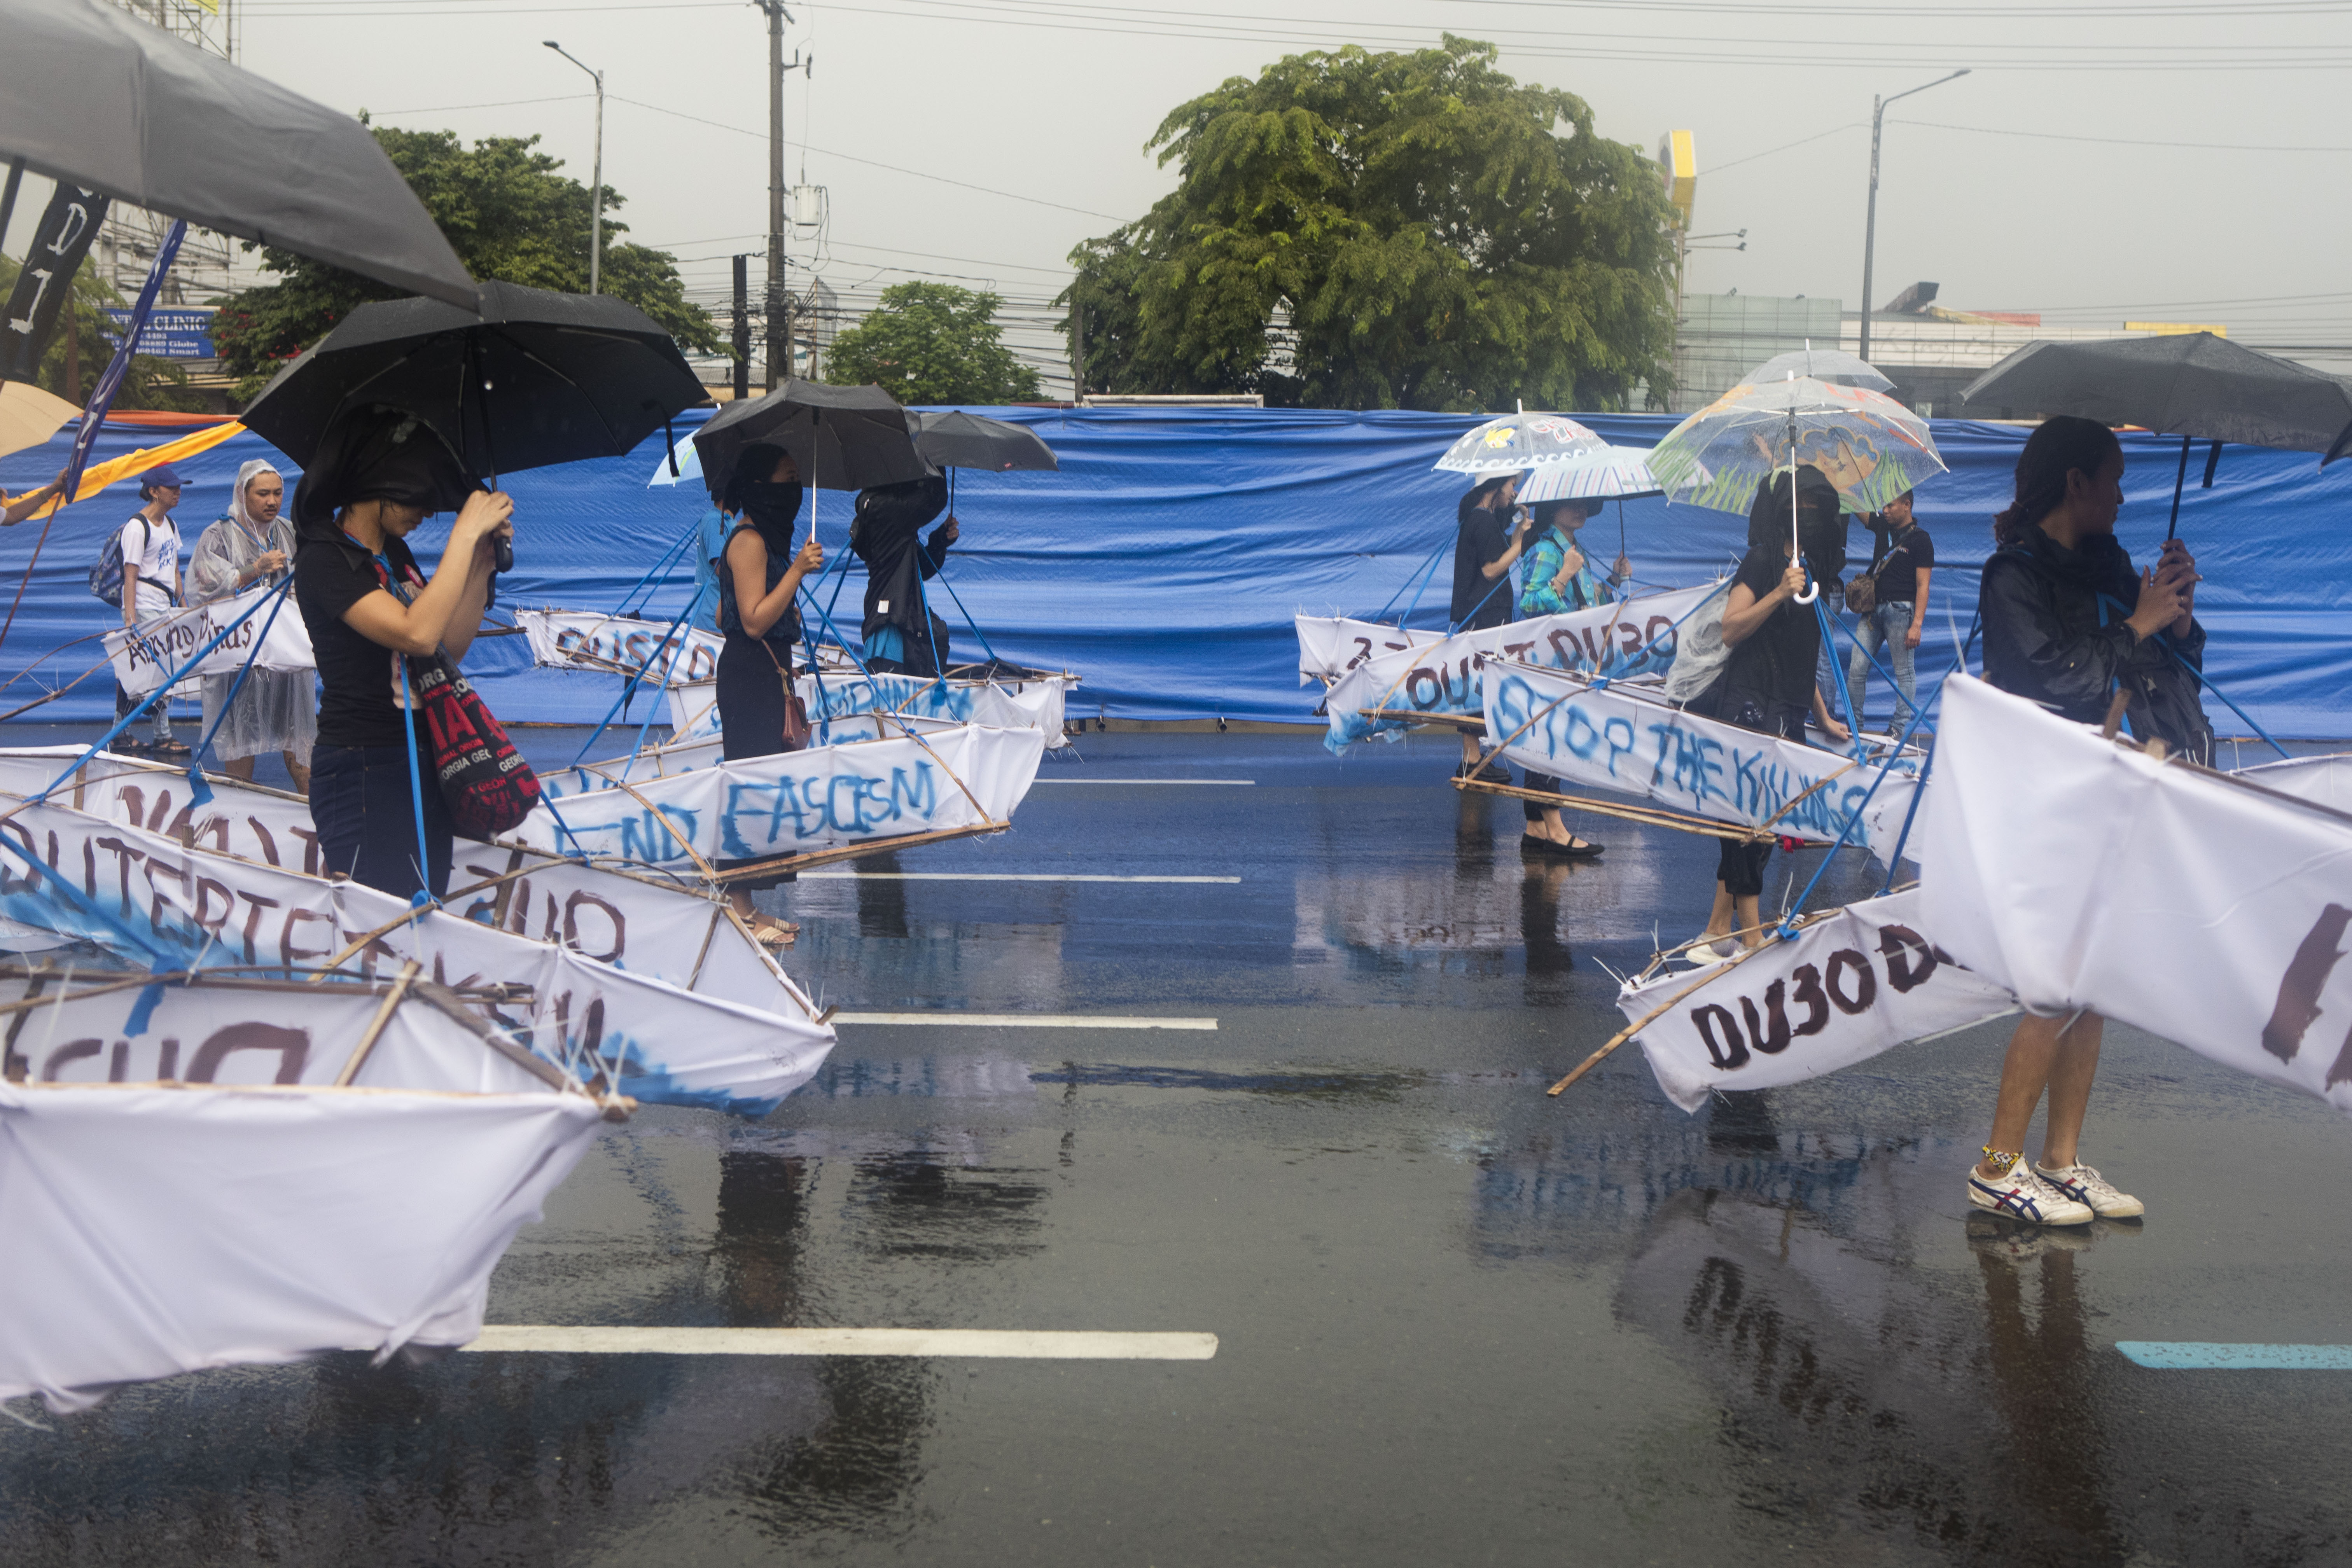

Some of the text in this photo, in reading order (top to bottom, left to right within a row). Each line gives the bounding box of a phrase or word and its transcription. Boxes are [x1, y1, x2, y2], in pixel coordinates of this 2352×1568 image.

[154, 316, 206, 330] CLINIC
[1492, 675, 1634, 778] STOP
[1647, 722, 1729, 812] THE
[553, 802, 701, 868] END
[721, 760, 935, 858] FASCISM
